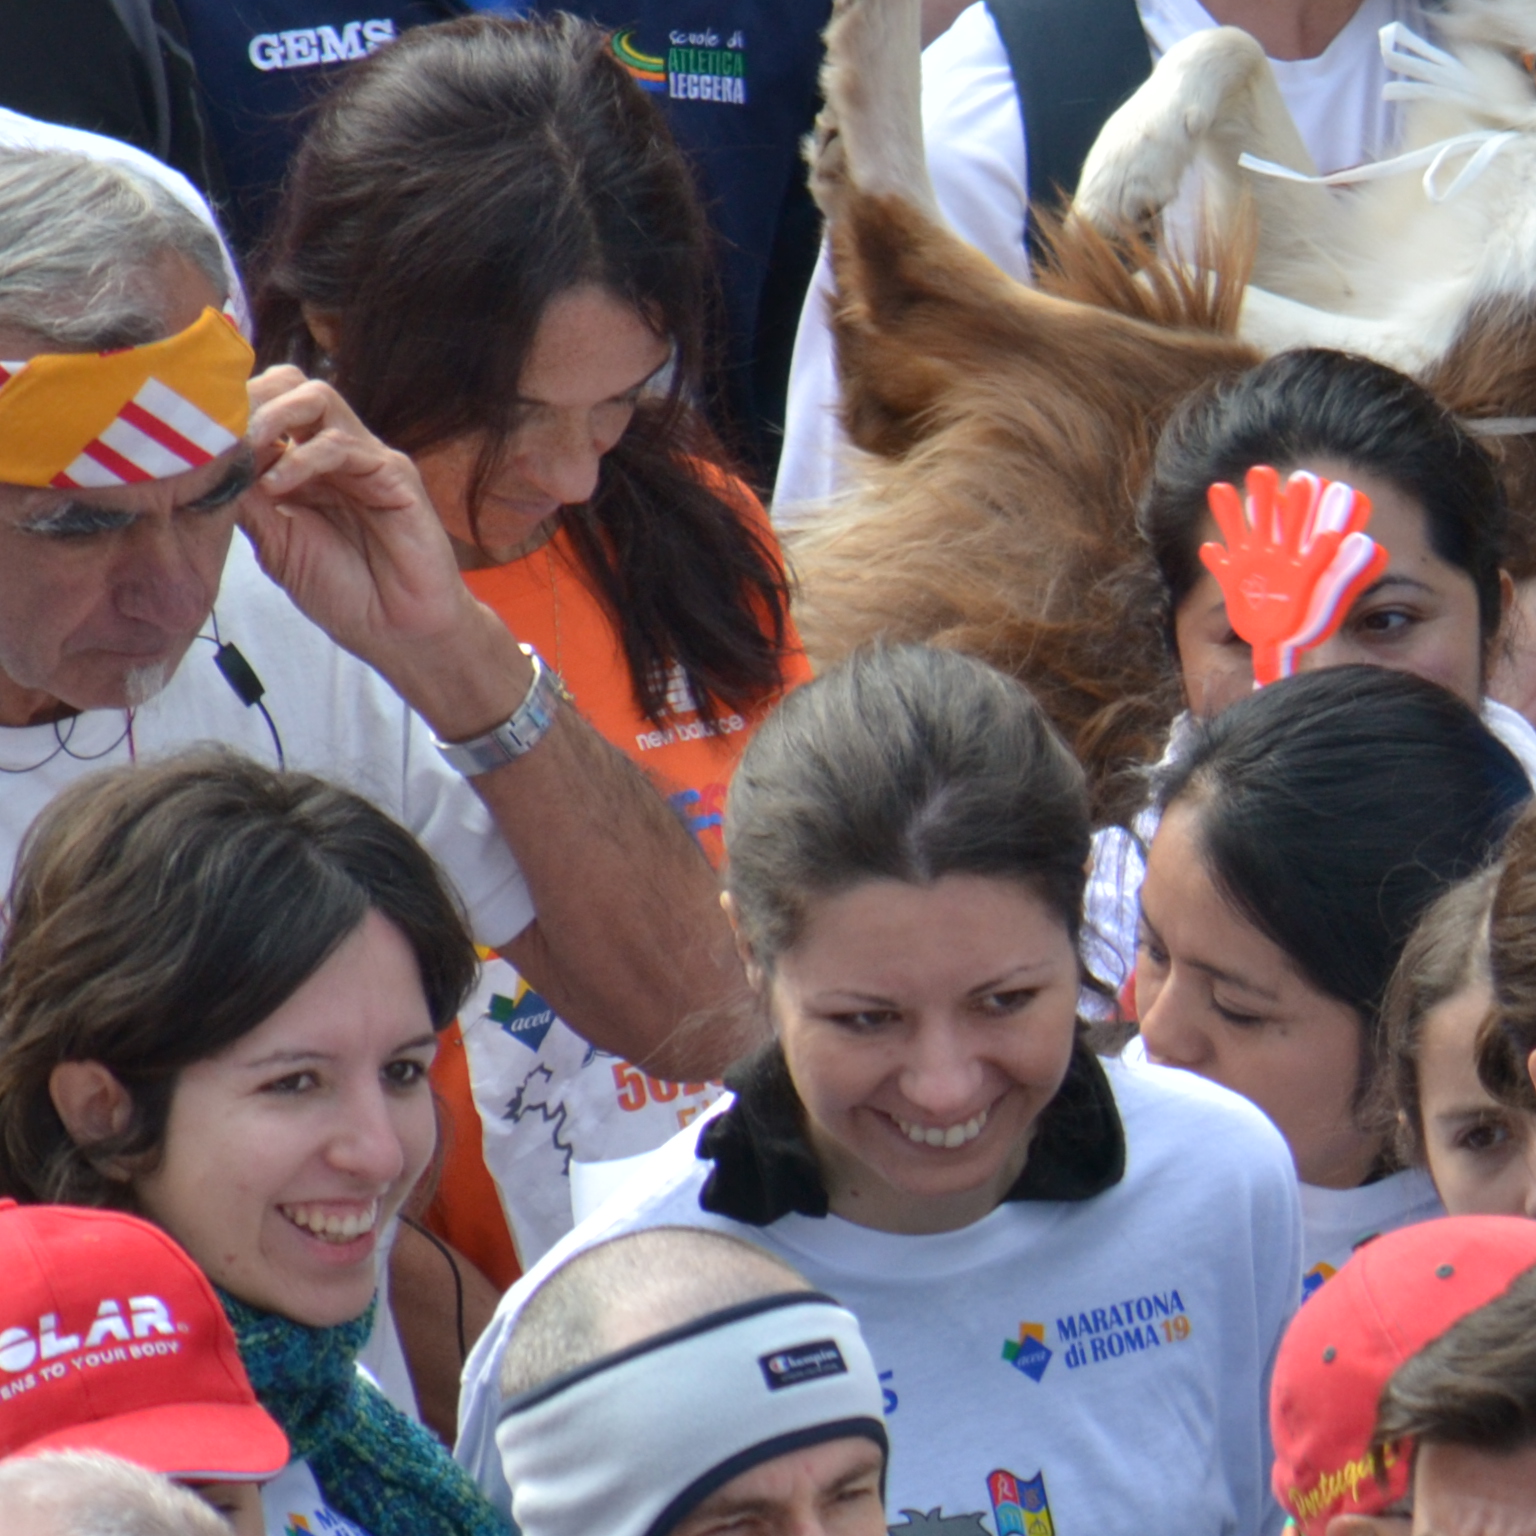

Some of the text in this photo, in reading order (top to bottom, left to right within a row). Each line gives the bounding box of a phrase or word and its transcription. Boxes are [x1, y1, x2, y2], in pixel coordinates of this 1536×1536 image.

[248, 18, 396, 71] GEMS
[669, 47, 743, 77] ATLETICA
[670, 72, 745, 104] LEGGERA
[1056, 1289, 1185, 1342] MARATONA
[40, 1362, 67, 1382] TO
[71, 1346, 128, 1371] YOUR
[128, 1340, 180, 1360] BODY
[1064, 1315, 1192, 1370] di ROMA 19
